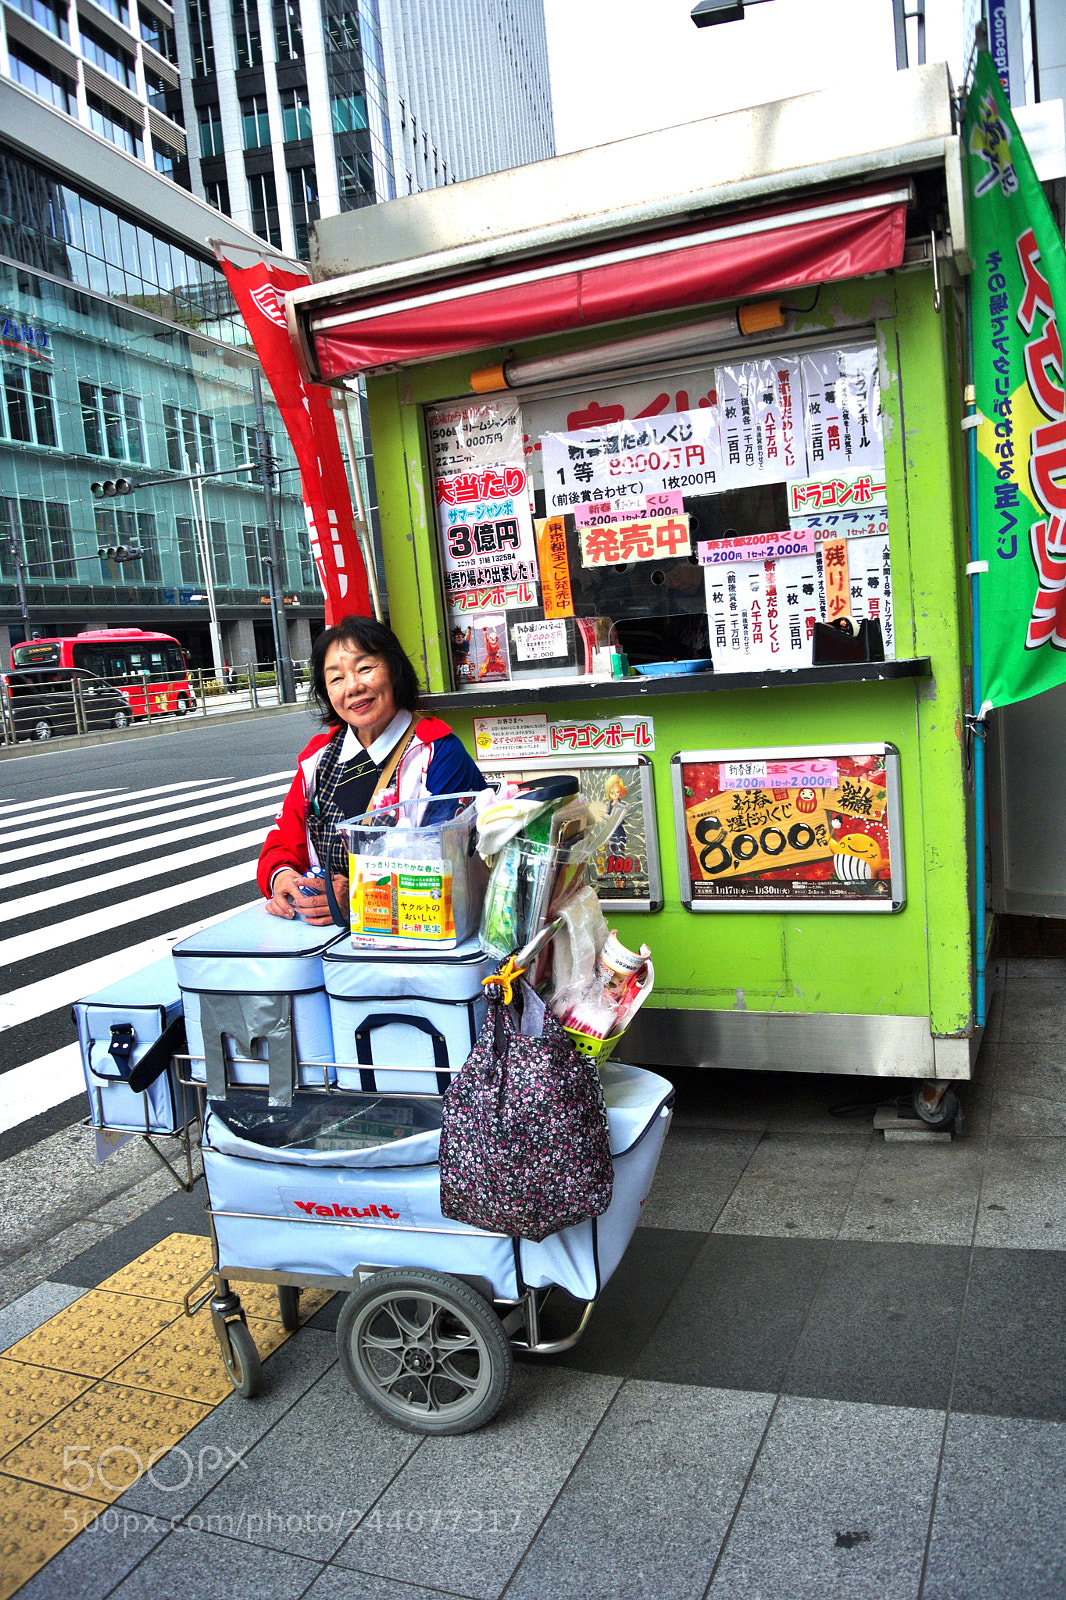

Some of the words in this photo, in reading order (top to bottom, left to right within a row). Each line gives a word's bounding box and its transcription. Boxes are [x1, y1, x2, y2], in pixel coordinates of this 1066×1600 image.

[993, 6, 1009, 74] Concept
[0, 317, 47, 347] ZUHO
[726, 427, 740, 465] 二百円
[765, 412, 778, 458] 八千万円
[825, 416, 841, 451] 一億円
[609, 444, 706, 476] 8000万円
[435, 467, 526, 506] 大当たり
[551, 481, 644, 508] (前後賞合わせて)
[661, 471, 716, 490] 1枚200円
[448, 500, 514, 524] サマージャンボ
[448, 518, 521, 559] 3億円
[585, 519, 689, 563] 発売中
[702, 551, 743, 564] 1枚200円
[747, 543, 809, 559] 1セット2,000円
[707, 531, 806, 551] 東京都200円くじ
[714, 612, 727, 648] 二百円
[750, 599, 764, 644] 八千万円
[788, 613, 802, 650] 三百円
[550, 724, 652, 750] ドラゴンボール
[725, 778, 766, 789] 1枚200円
[695, 816, 816, 875] 8,000
[364, 861, 440, 874] すっきりさわやかな春に
[400, 903, 440, 913] ヤクルトの
[405, 912, 437, 922] おいしい
[401, 922, 441, 934] はっ酵果実
[293, 1200, 400, 1220] Yakult
